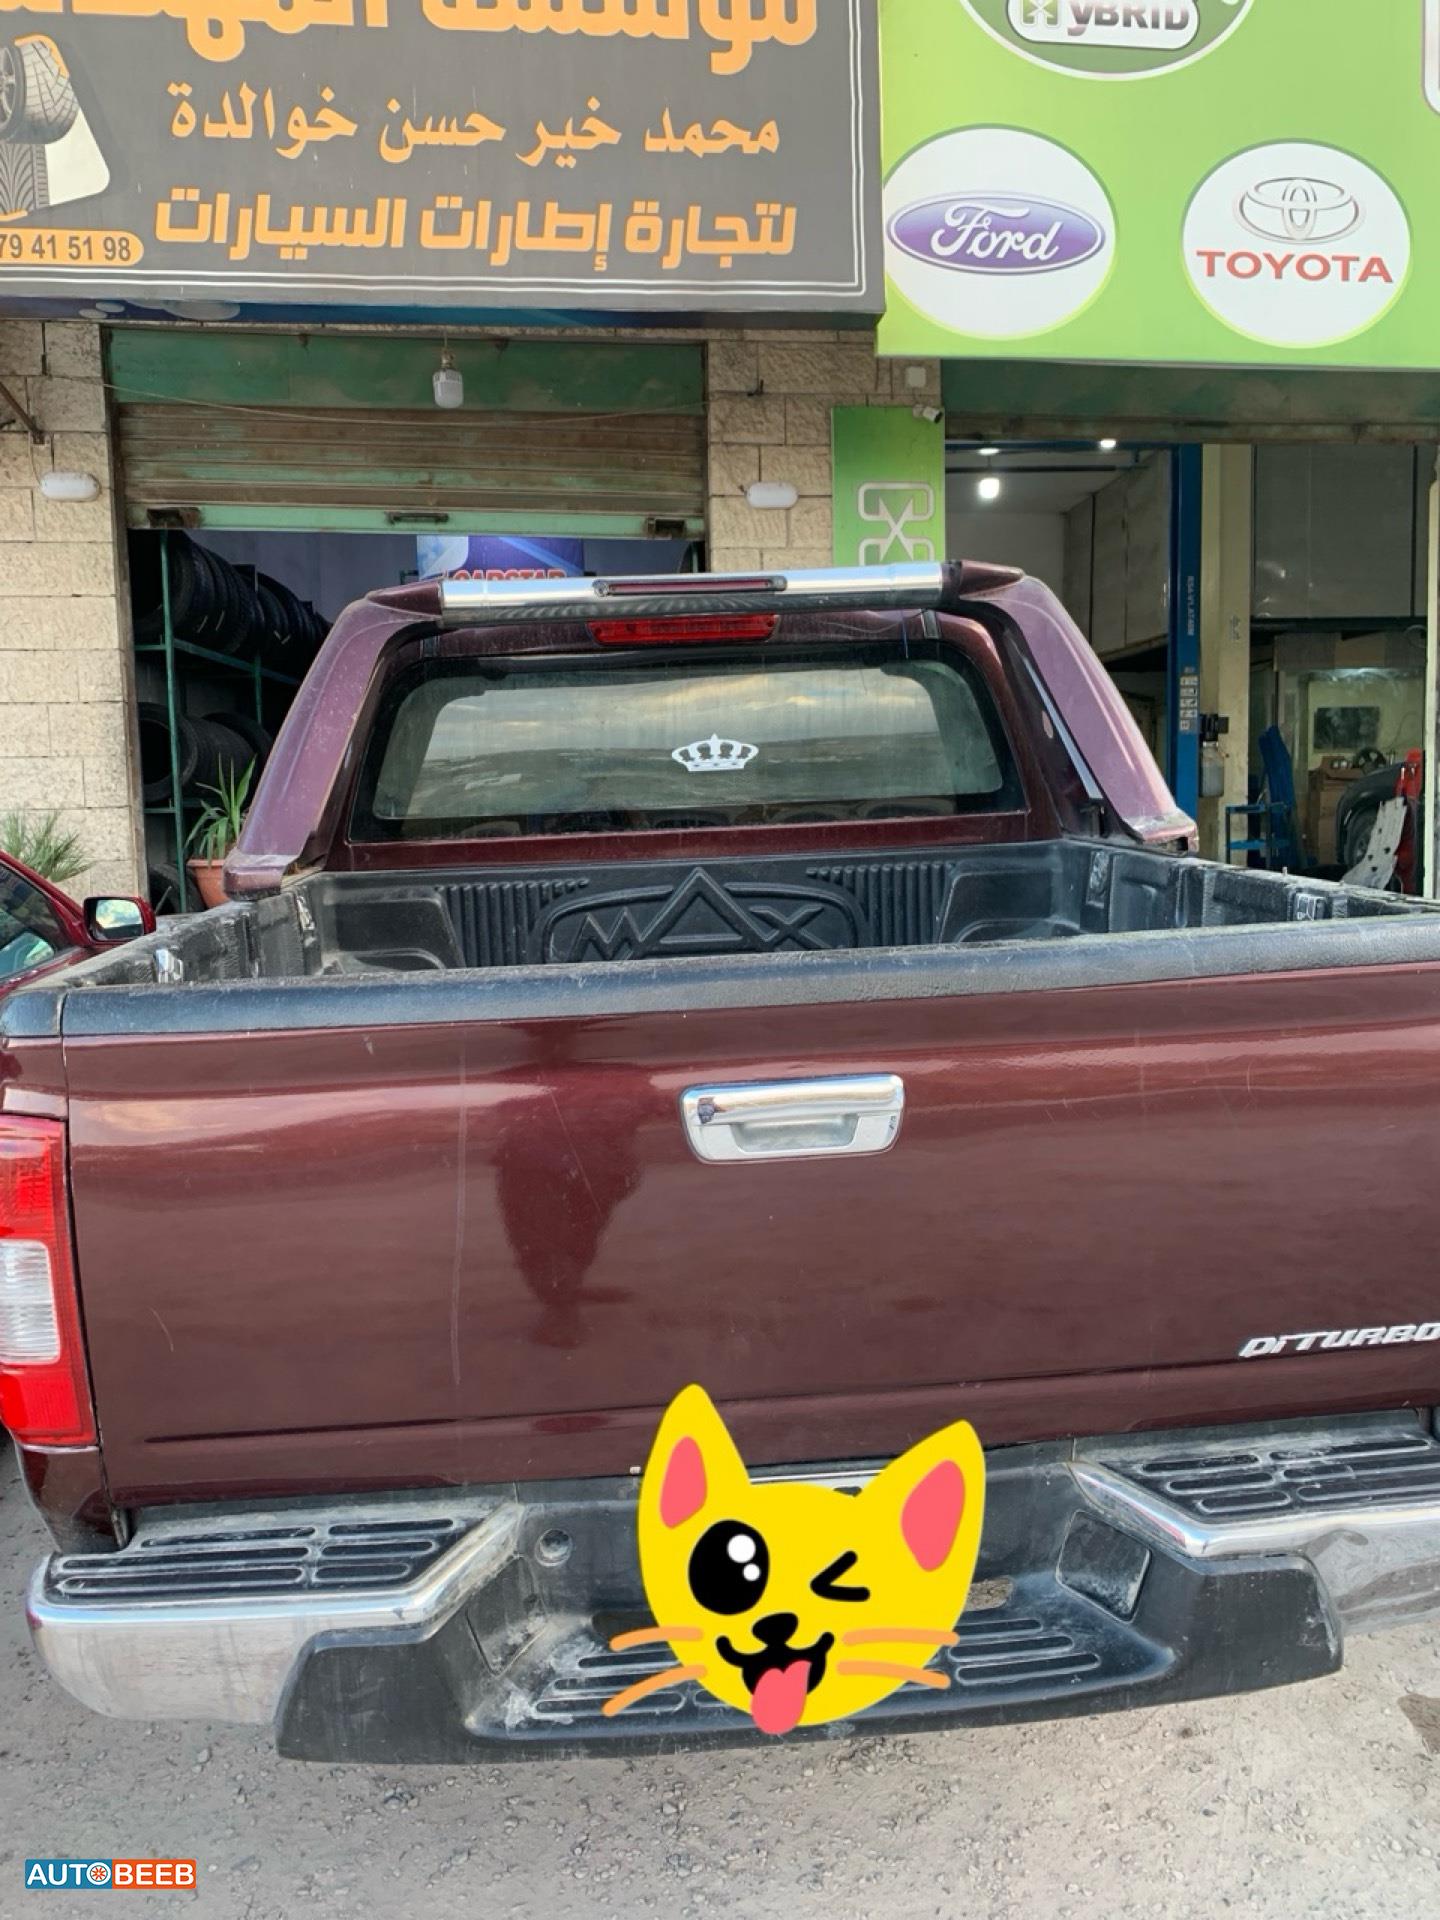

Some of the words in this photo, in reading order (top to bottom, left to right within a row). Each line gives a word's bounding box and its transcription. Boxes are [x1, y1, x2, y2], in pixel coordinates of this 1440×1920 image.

[166, 81, 357, 159] خوالدة
[379, 98, 507, 163] حسن
[516, 96, 622, 168] خير
[644, 106, 780, 158] محمد
[31, 234, 57, 259] 41
[68, 235, 93, 261] 51
[103, 236, 131, 262] 98
[155, 187, 407, 260] السيارات
[420, 195, 613, 271] إطارات
[624, 201, 797, 270] لتجارة
[930, 200, 1059, 262] Ford
[1196, 249, 1394, 284] TOYOTA
